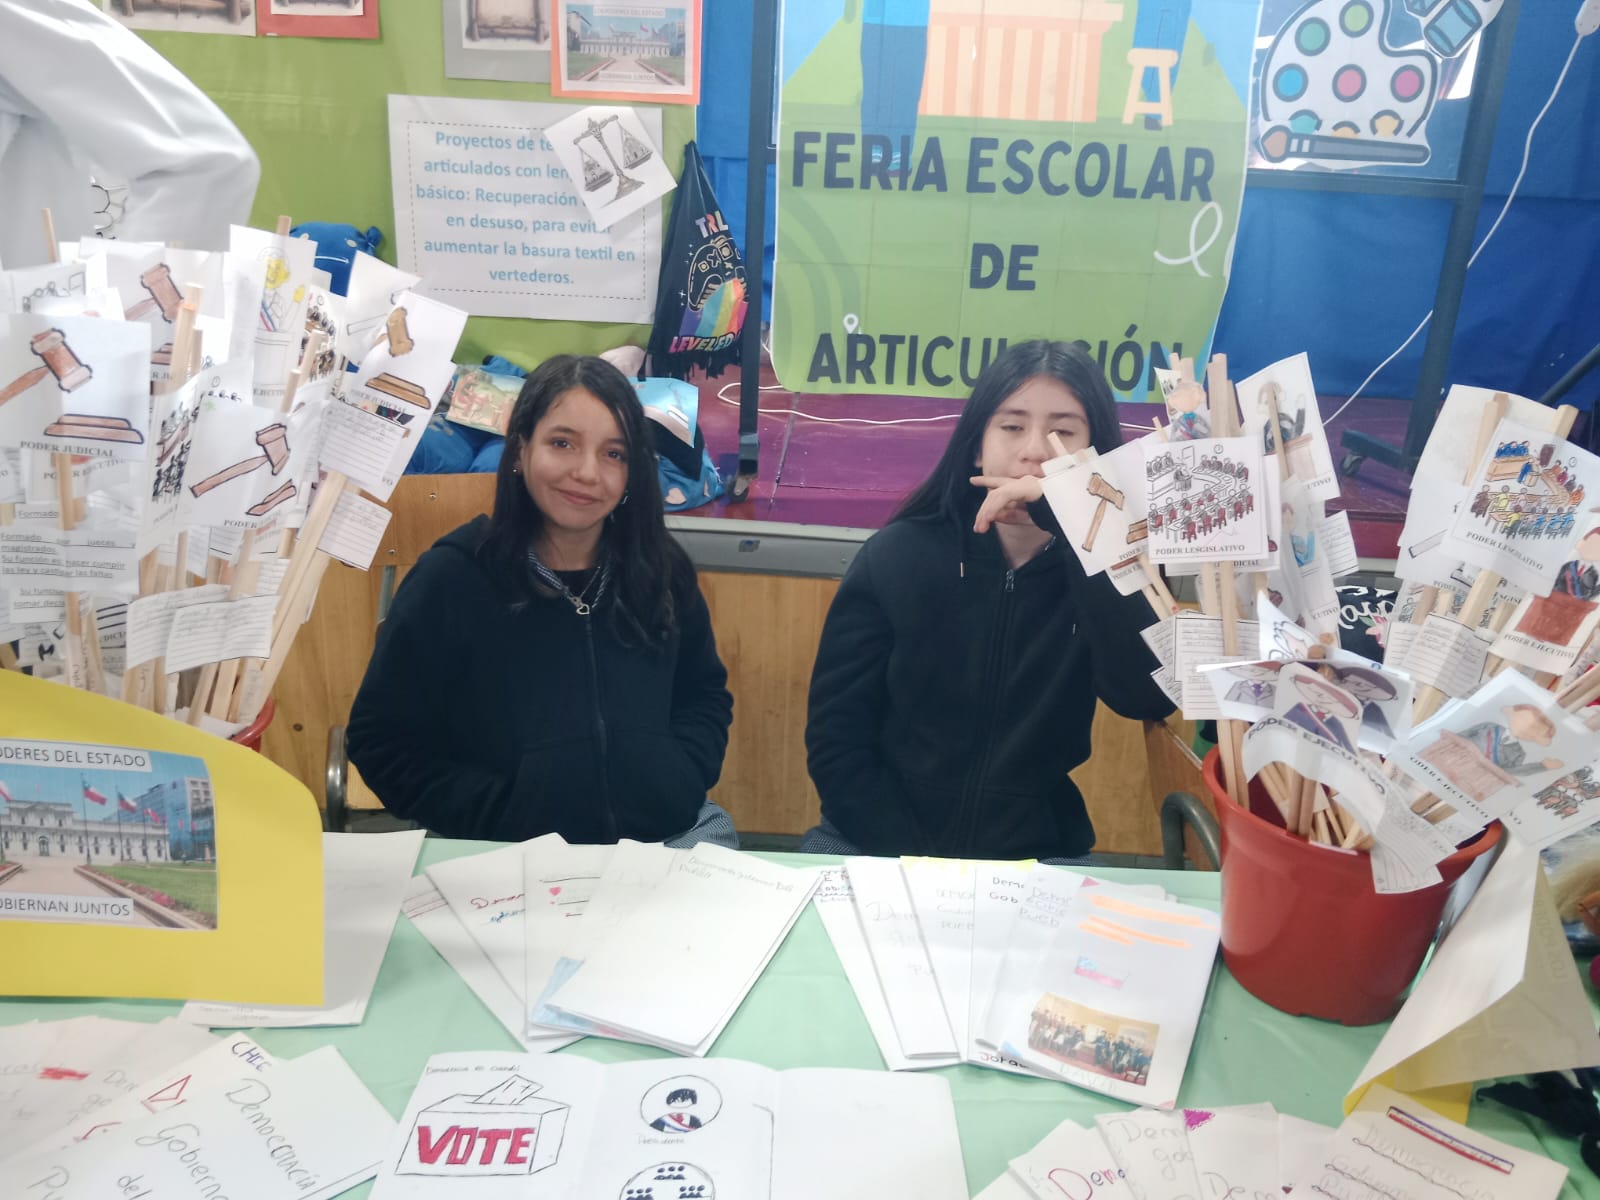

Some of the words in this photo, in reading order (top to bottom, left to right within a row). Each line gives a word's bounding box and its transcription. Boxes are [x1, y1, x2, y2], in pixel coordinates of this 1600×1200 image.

[436, 131, 511, 150] Proyectos
[516, 136, 535, 150] de
[539, 138, 555, 150] te
[424, 160, 511, 178] articulados
[515, 167, 542, 178] con
[546, 161, 573, 183] len
[792, 131, 948, 193] FERIA
[966, 137, 1215, 202] ESCOLAR
[416, 183, 471, 201] básico:
[475, 187, 577, 208] Recuperación
[446, 216, 465, 227] en
[470, 214, 528, 233] desuso,
[532, 220, 566, 236] para
[424, 240, 498, 255] aumentar
[503, 240, 517, 255] la
[521, 242, 571, 259] basura
[575, 245, 613, 262] textil
[617, 249, 636, 262] en
[969, 242, 1039, 291] DE
[489, 268, 575, 285] vertederos.
[806, 323, 1183, 393] ARTICUIÓN
[19, 440, 60, 454] PODER
[223, 519, 259, 530] PODER
[1465, 531, 1498, 548] PODER
[1155, 546, 1183, 556] PODER
[1503, 633, 1532, 648] PODER
[1247, 716, 1299, 740] PODER
[54, 749, 83, 764] DEL
[87, 753, 147, 768] ESTADO
[991, 875, 1025, 890] Dem
[988, 890, 1019, 905] Gob
[73, 902, 131, 917] JUNTOS
[417, 1124, 536, 1166] VOTE
[134, 1122, 230, 1200] Gobiern
